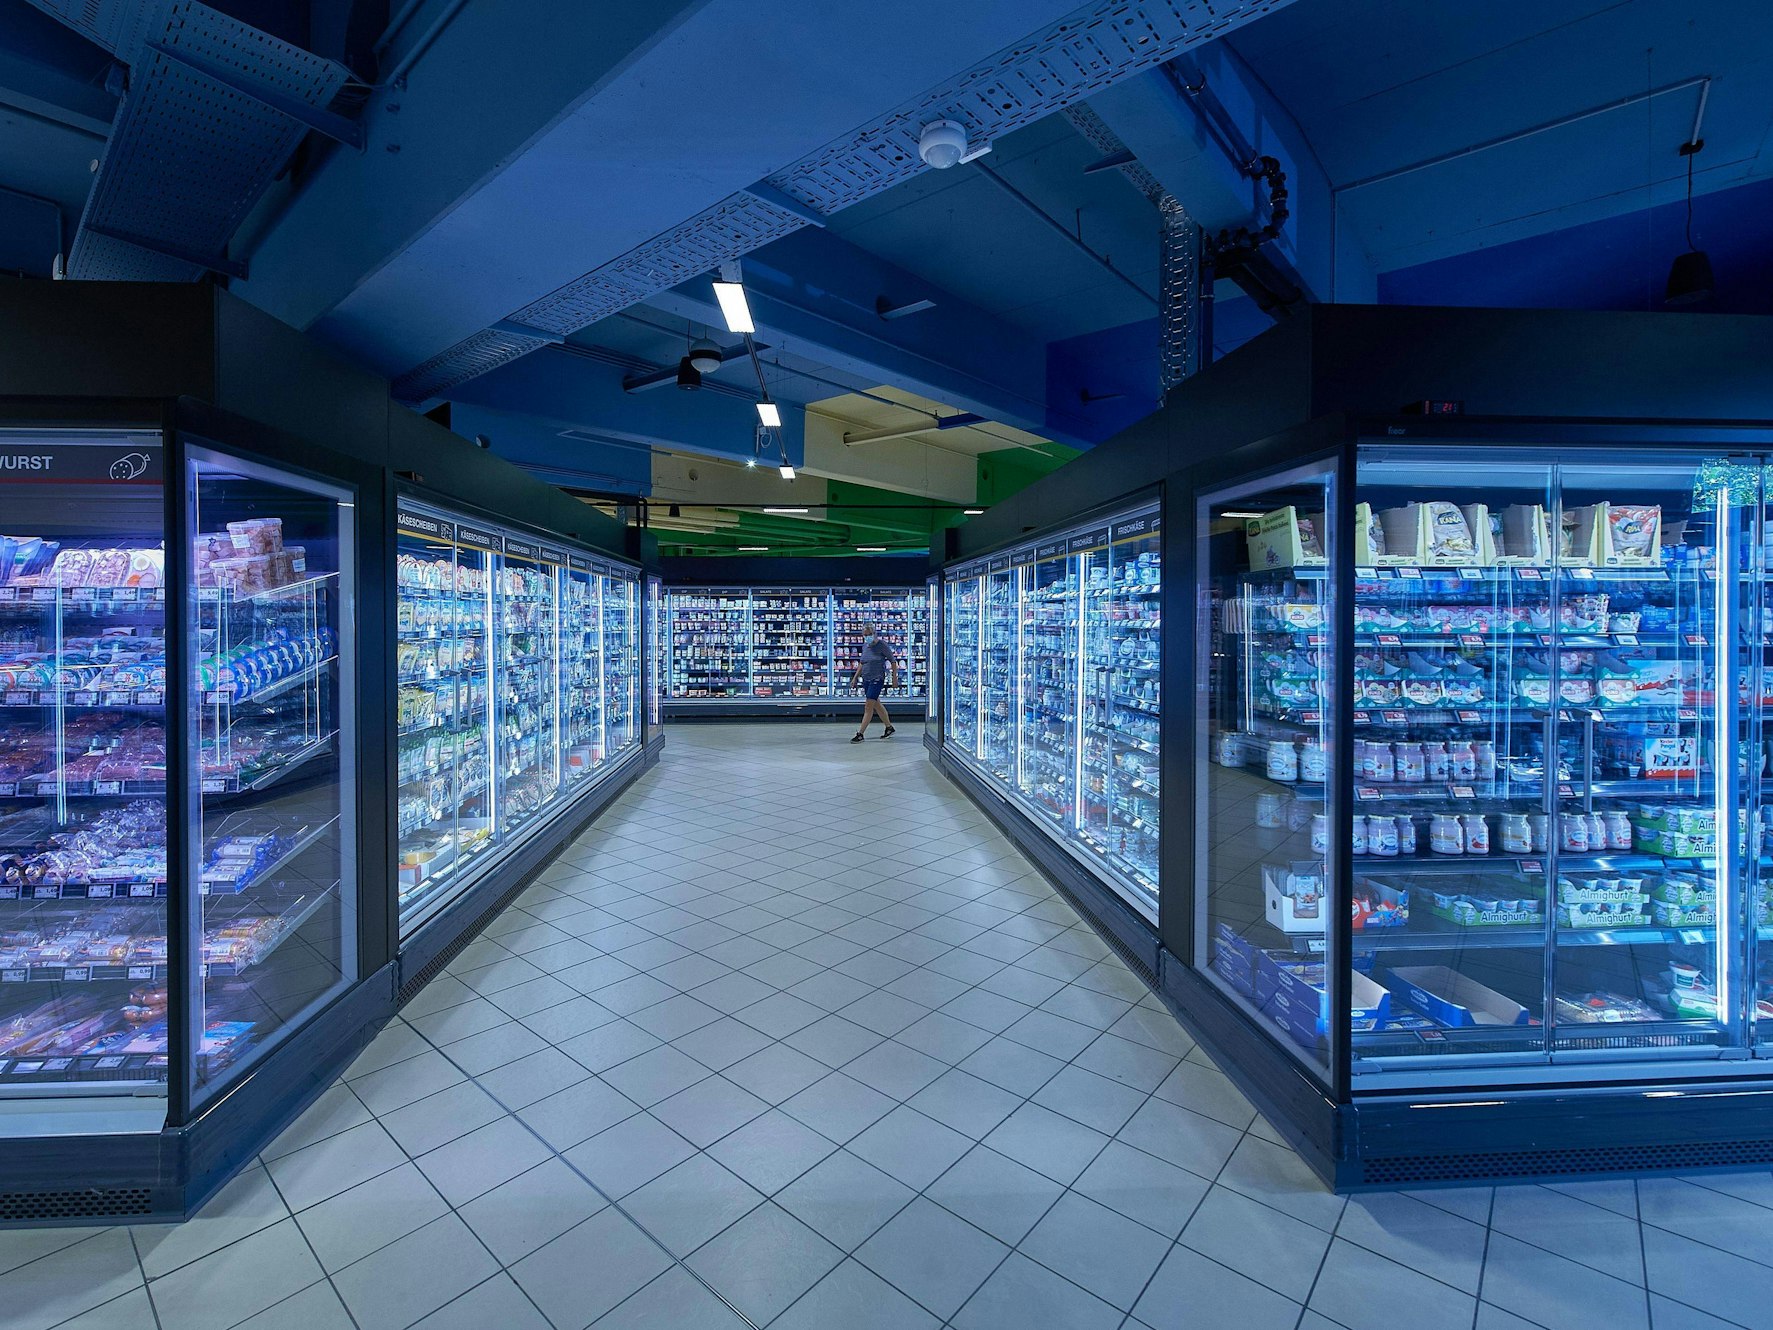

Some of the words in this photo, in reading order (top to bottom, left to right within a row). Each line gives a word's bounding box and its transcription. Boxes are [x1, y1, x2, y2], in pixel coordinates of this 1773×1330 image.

[398, 513, 438, 533] KÄSESCHEIBEN
[1580, 889, 1628, 902] Almighurt
[1481, 911, 1527, 923] Almighurt
[1586, 912, 1631, 925] Almighurt
